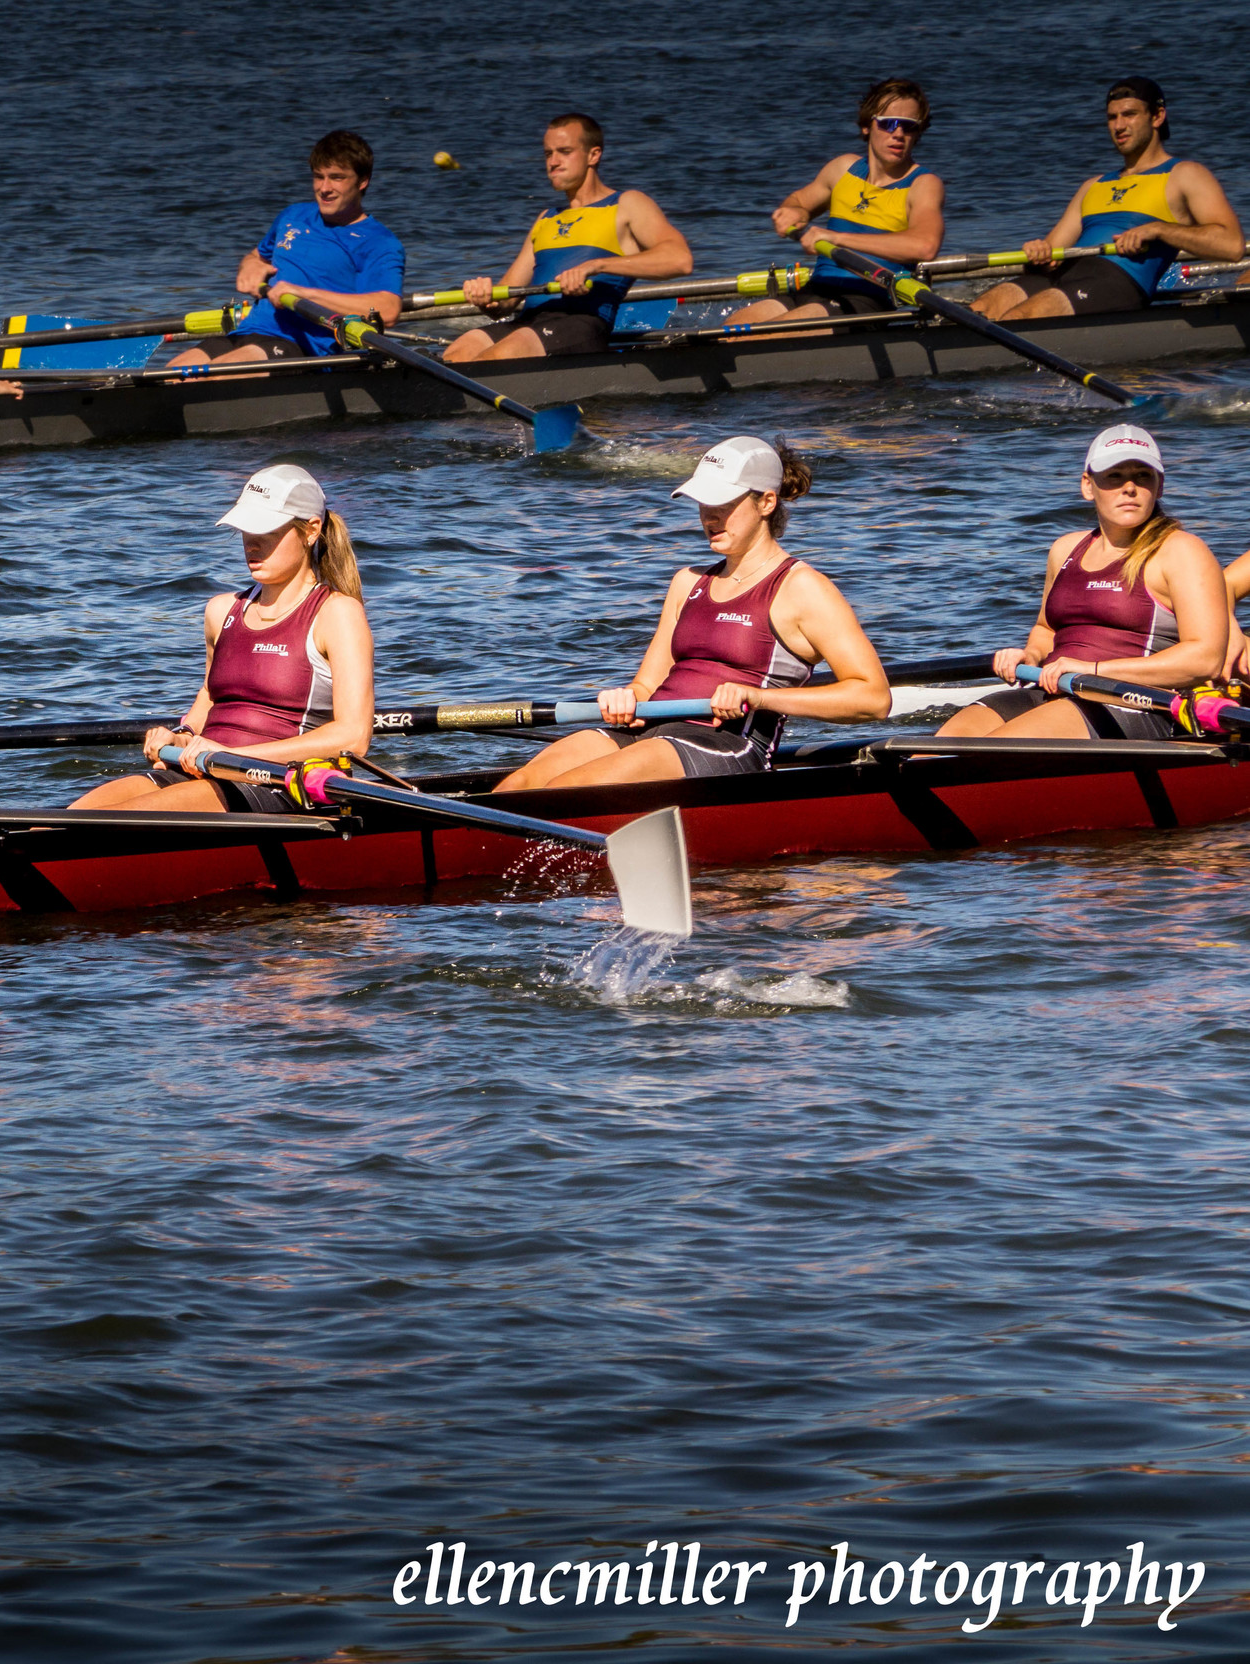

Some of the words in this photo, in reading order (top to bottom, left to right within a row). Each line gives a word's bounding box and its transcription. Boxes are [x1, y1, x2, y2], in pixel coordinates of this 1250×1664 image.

[1086, 581, 1121, 589] PhilaU
[715, 612, 751, 621] PhilaU
[252, 643, 287, 653] PhilaU
[373, 712, 414, 729] OKER
